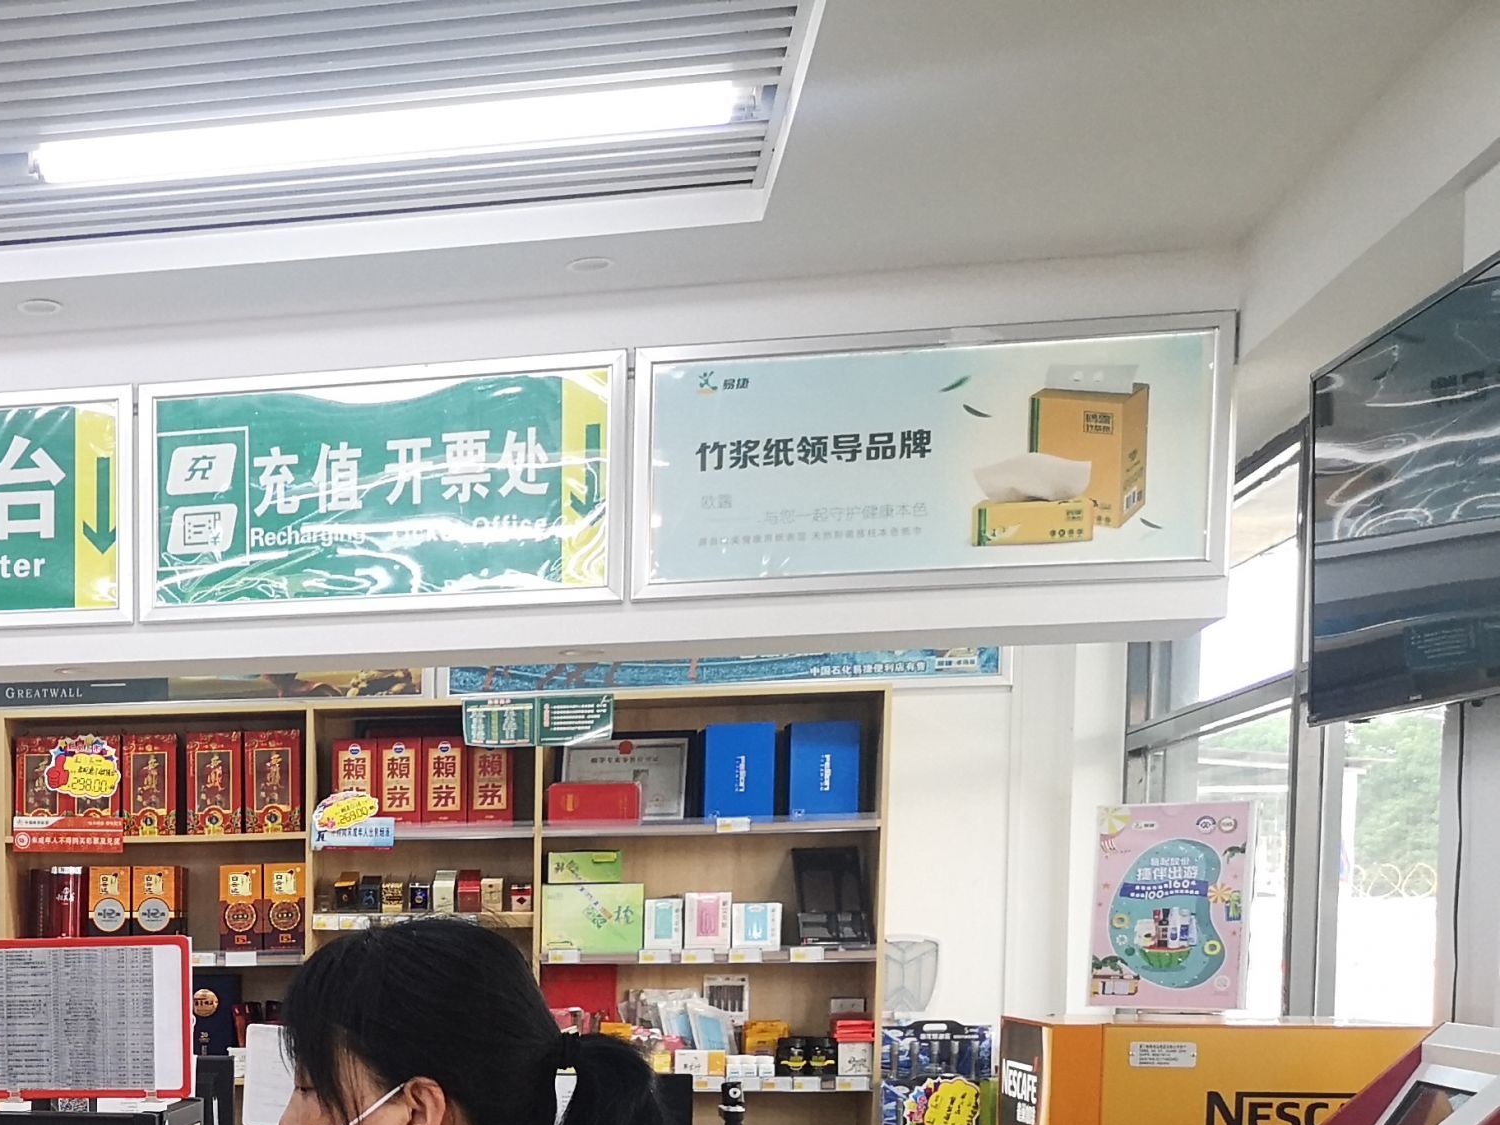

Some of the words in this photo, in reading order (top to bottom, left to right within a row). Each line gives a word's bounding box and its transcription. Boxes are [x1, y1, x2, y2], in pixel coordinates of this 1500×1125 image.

[253, 443, 363, 517] 充值
[385, 427, 550, 506] 开票处
[695, 429, 933, 472] 竹浆纸领导品牌
[6, 686, 83, 700] GREATWALL
